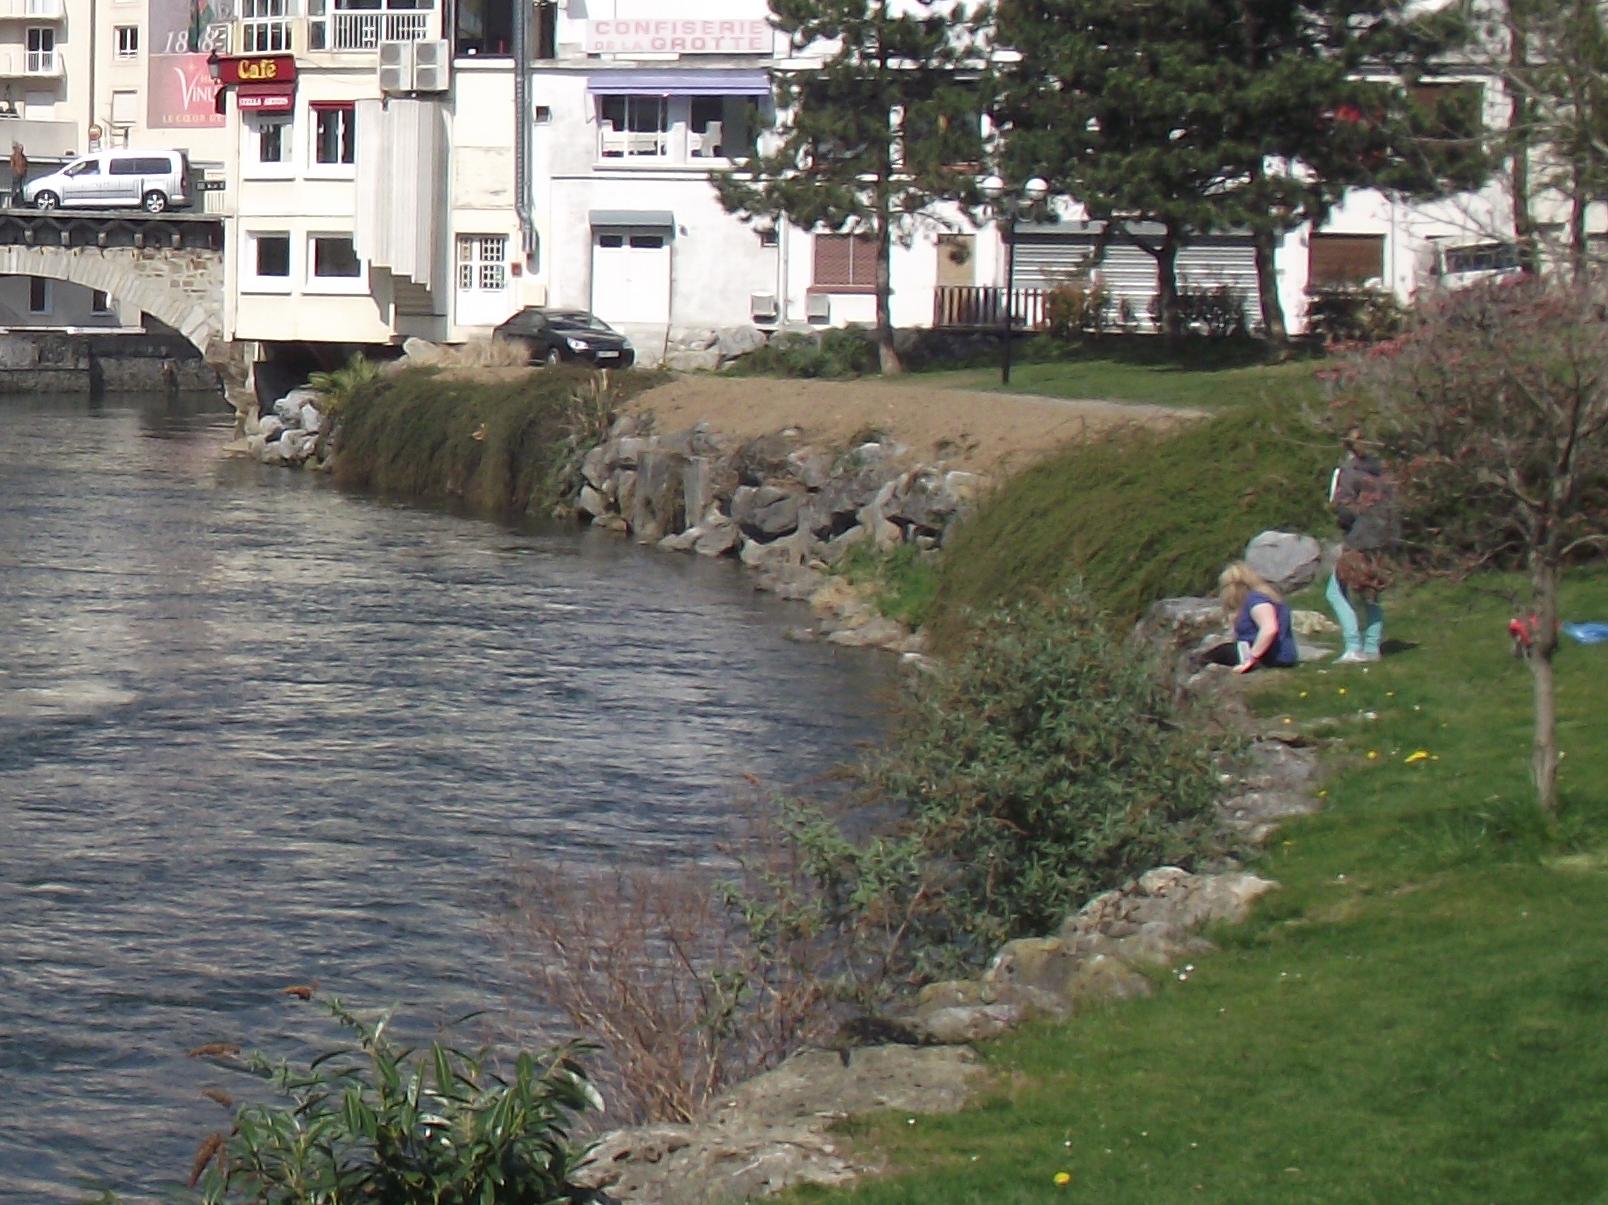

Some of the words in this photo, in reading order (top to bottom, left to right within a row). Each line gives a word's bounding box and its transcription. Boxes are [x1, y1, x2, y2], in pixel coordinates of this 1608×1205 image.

[595, 21, 763, 35] CONFISERIE
[650, 36, 763, 50] GROTTE
[237, 59, 277, 80] Café
